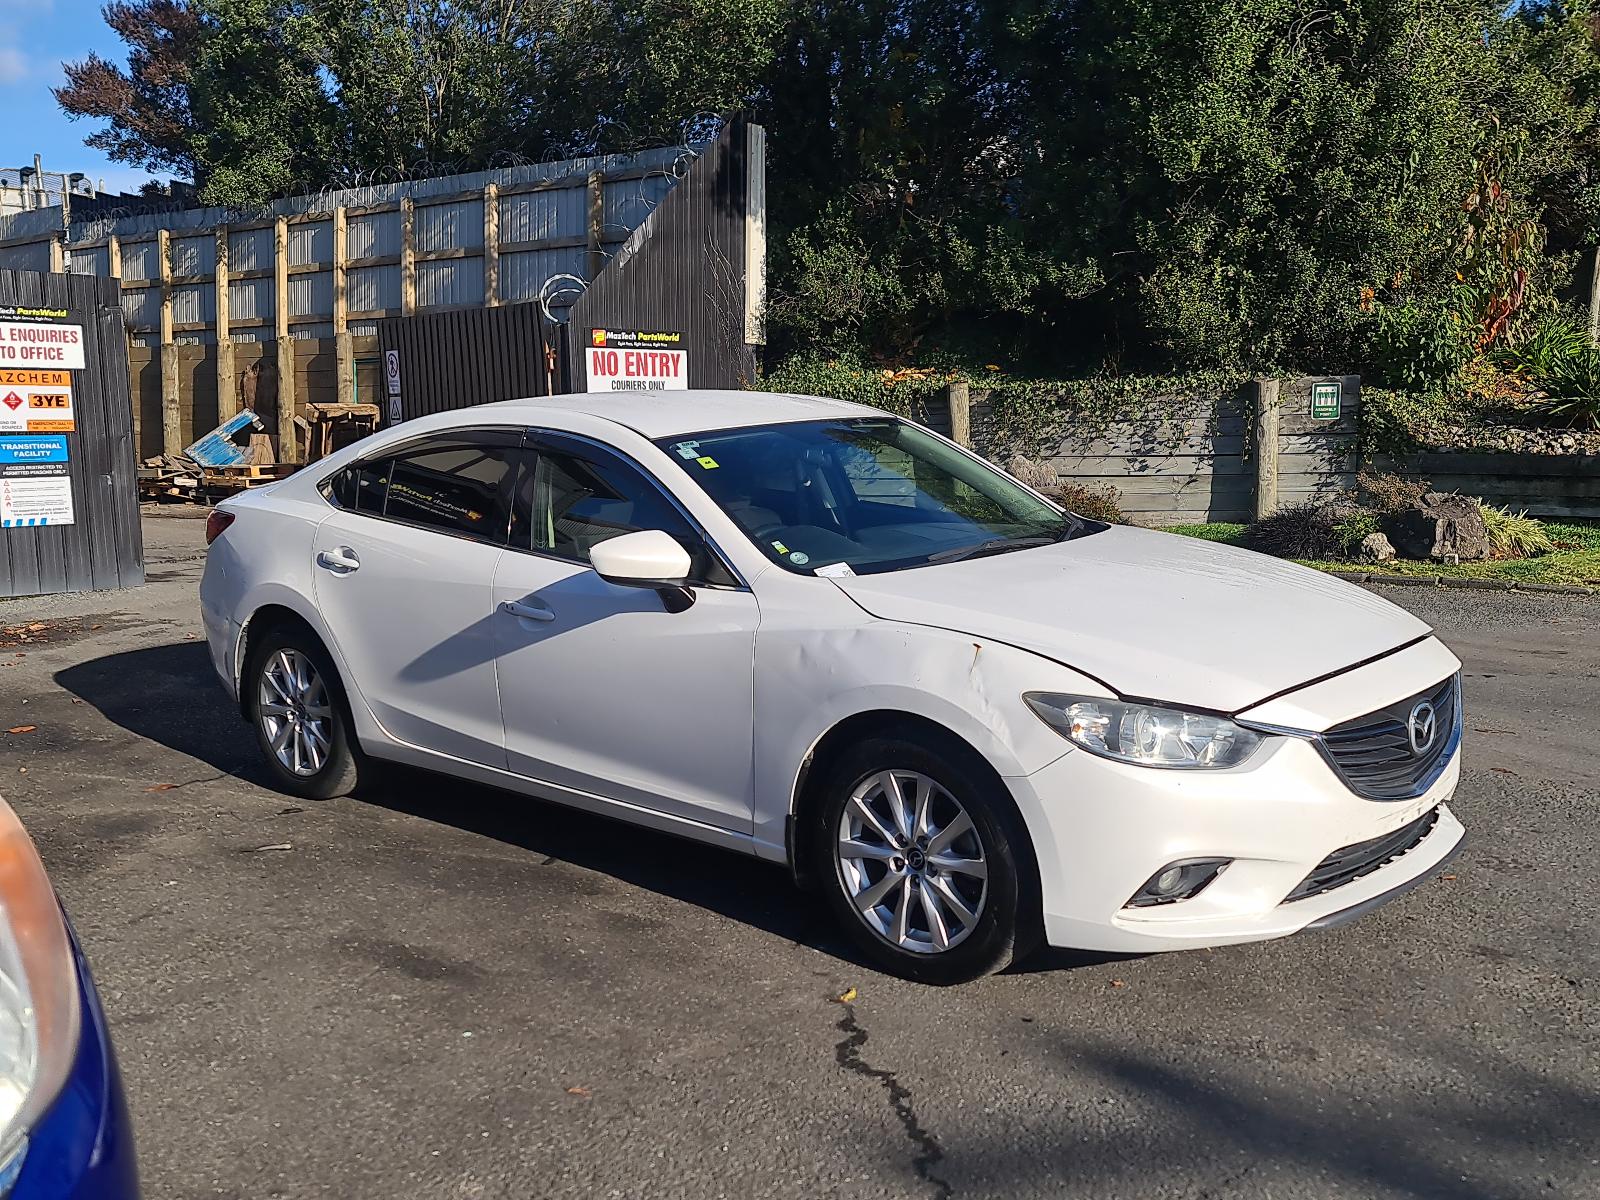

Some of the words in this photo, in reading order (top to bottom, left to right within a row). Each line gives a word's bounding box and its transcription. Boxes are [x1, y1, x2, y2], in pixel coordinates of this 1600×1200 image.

[17, 307, 67, 317] PartsWorld
[10, 328, 79, 343] ENQUIRIES
[606, 331, 636, 340] MazTech
[637, 332, 680, 341] PartsWorld
[0, 346, 16, 359] TO
[20, 346, 64, 360] OFFICE
[592, 351, 619, 376] NO
[624, 351, 681, 377] ENTRY
[611, 380, 647, 391] COURIERS
[648, 380, 666, 391] ONLY
[33, 395, 65, 407] 3YE
